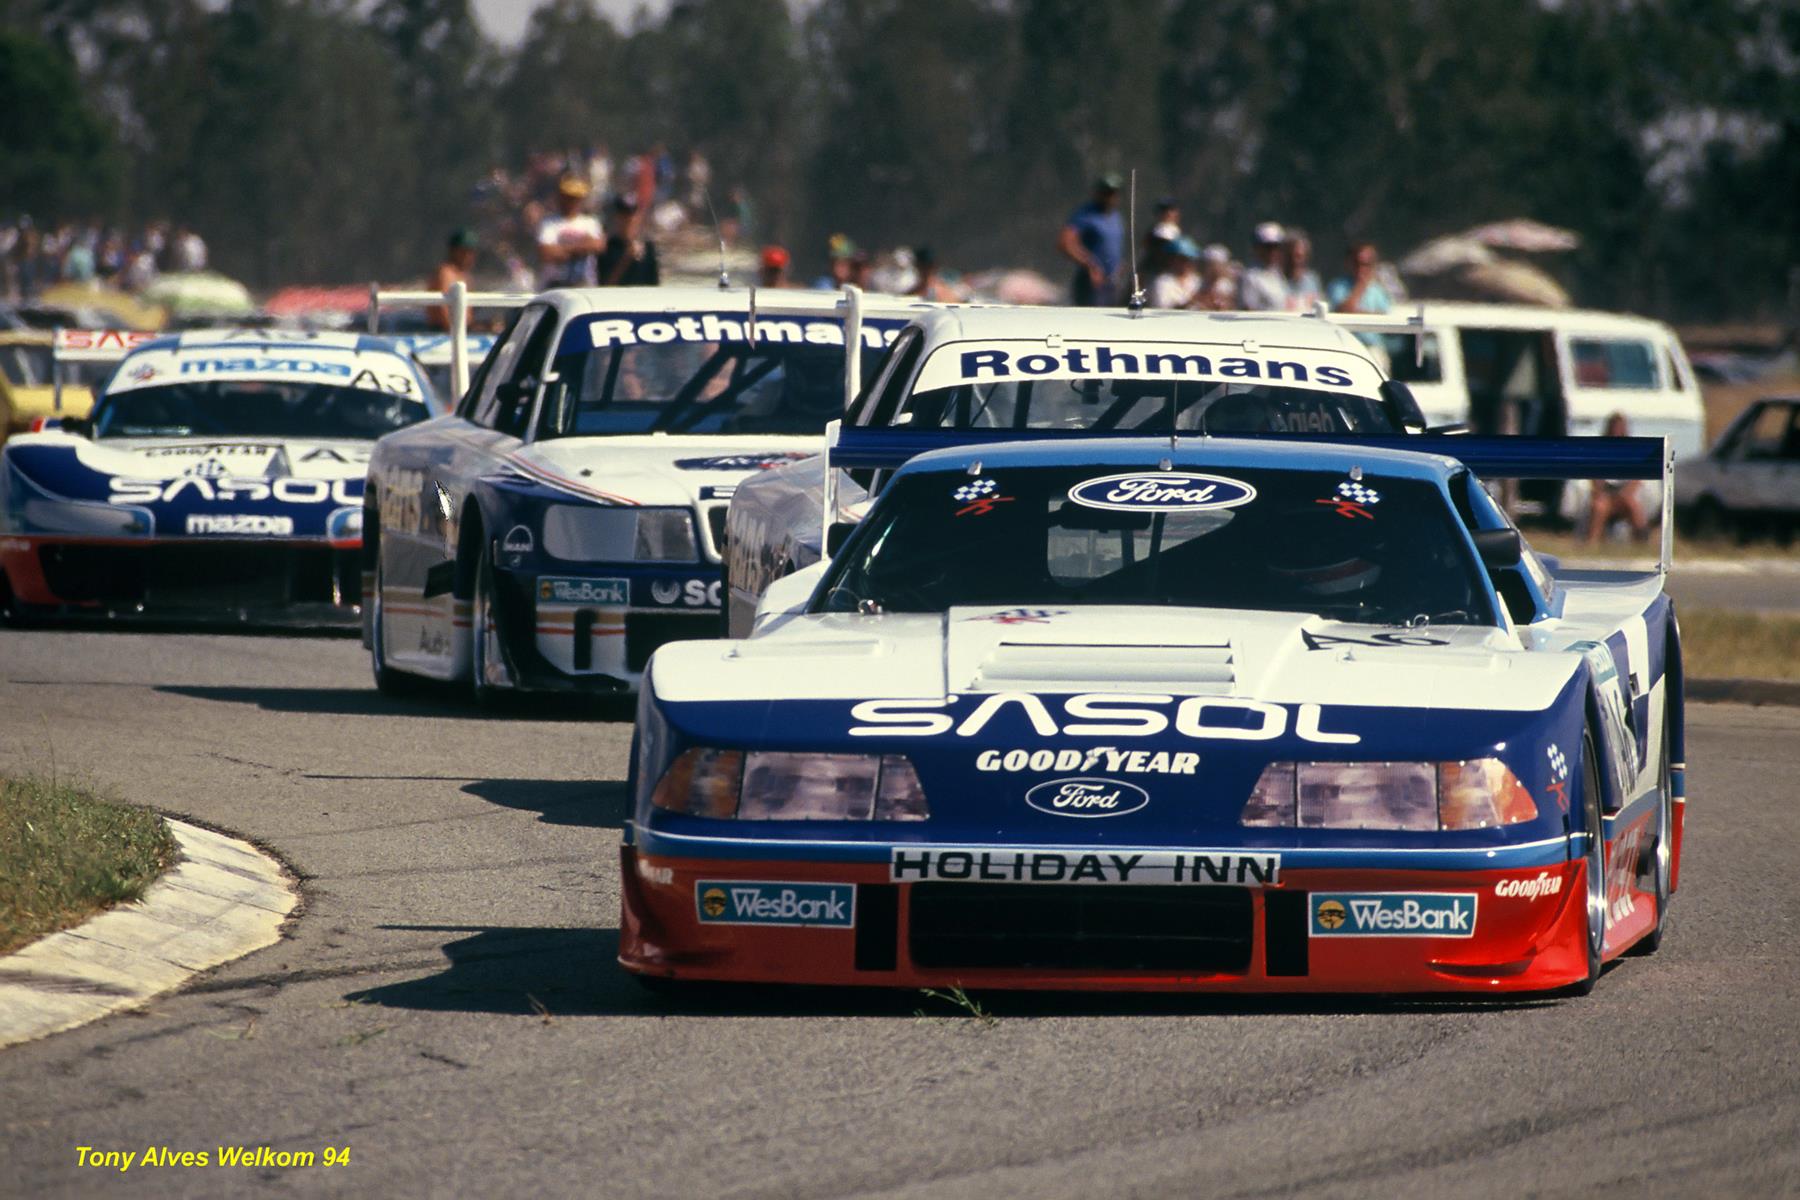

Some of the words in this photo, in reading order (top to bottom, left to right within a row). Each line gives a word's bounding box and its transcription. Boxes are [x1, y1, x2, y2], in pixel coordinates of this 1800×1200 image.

[180, 358, 351, 377] mazda
[960, 346, 1354, 387] Rothmans
[351, 368, 412, 395] A3
[107, 475, 364, 506] SASOL
[1106, 477, 1215, 504] Ford
[186, 513, 294, 535] mazda
[552, 580, 625, 602] WesBank
[1301, 628, 1450, 651] A6
[848, 692, 1361, 744] SASOL
[976, 746, 1200, 774] GOODYEAR
[1053, 782, 1119, 810] Ford
[894, 850, 1144, 882] HOLIDAY
[1173, 854, 1276, 884] INN
[730, 887, 855, 920] WesBank
[1349, 899, 1469, 930] WesBank
